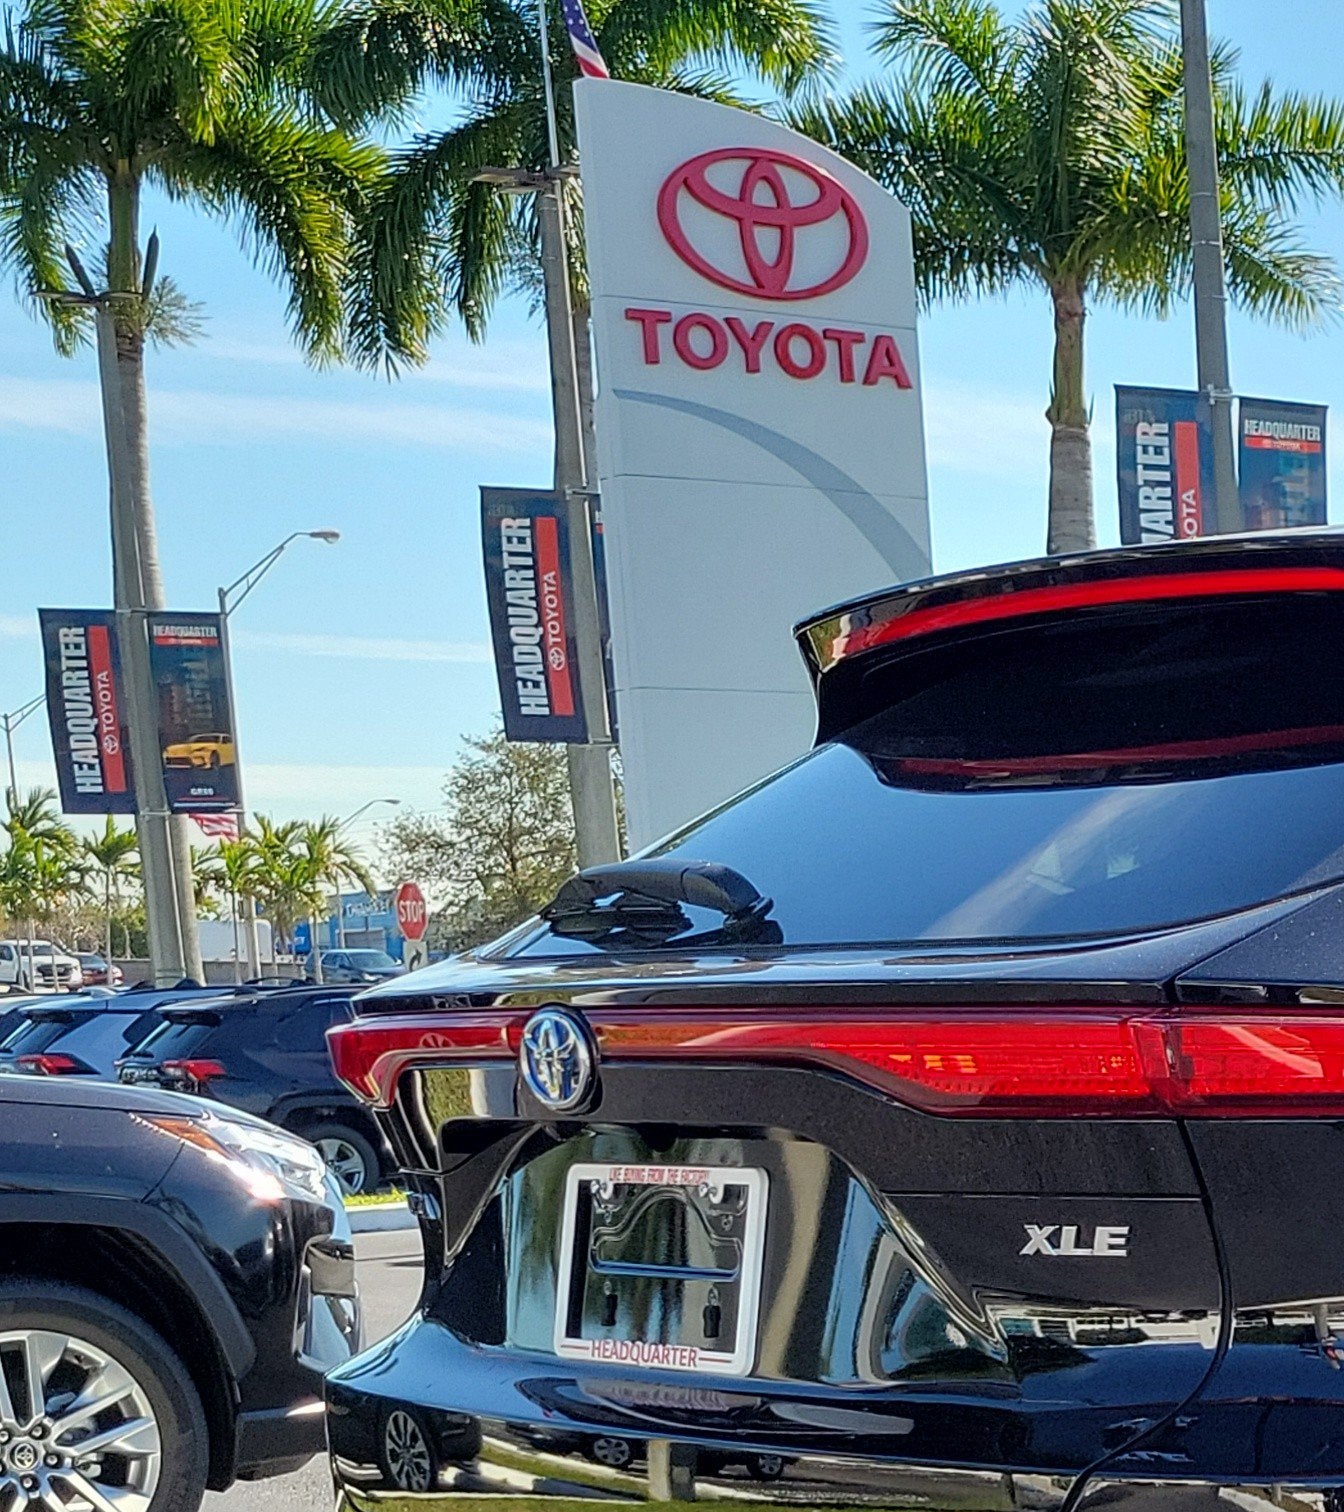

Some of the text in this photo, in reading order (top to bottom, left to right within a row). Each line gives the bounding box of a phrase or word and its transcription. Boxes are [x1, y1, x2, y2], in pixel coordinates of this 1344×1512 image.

[625, 308, 912, 390] TOYOTA
[1244, 419, 1320, 441] HEADQUARTER
[1182, 489, 1198, 539] OTA
[501, 517, 550, 716] HEADQUARTER
[543, 571, 564, 643] TOYOTA
[59, 627, 103, 793] HEADQUARTER
[97, 671, 116, 733] TOYOTA
[399, 900, 424, 923] STOP
[1019, 1224, 1130, 1257] XLE
[591, 1340, 698, 1367] HEADQUARTER
